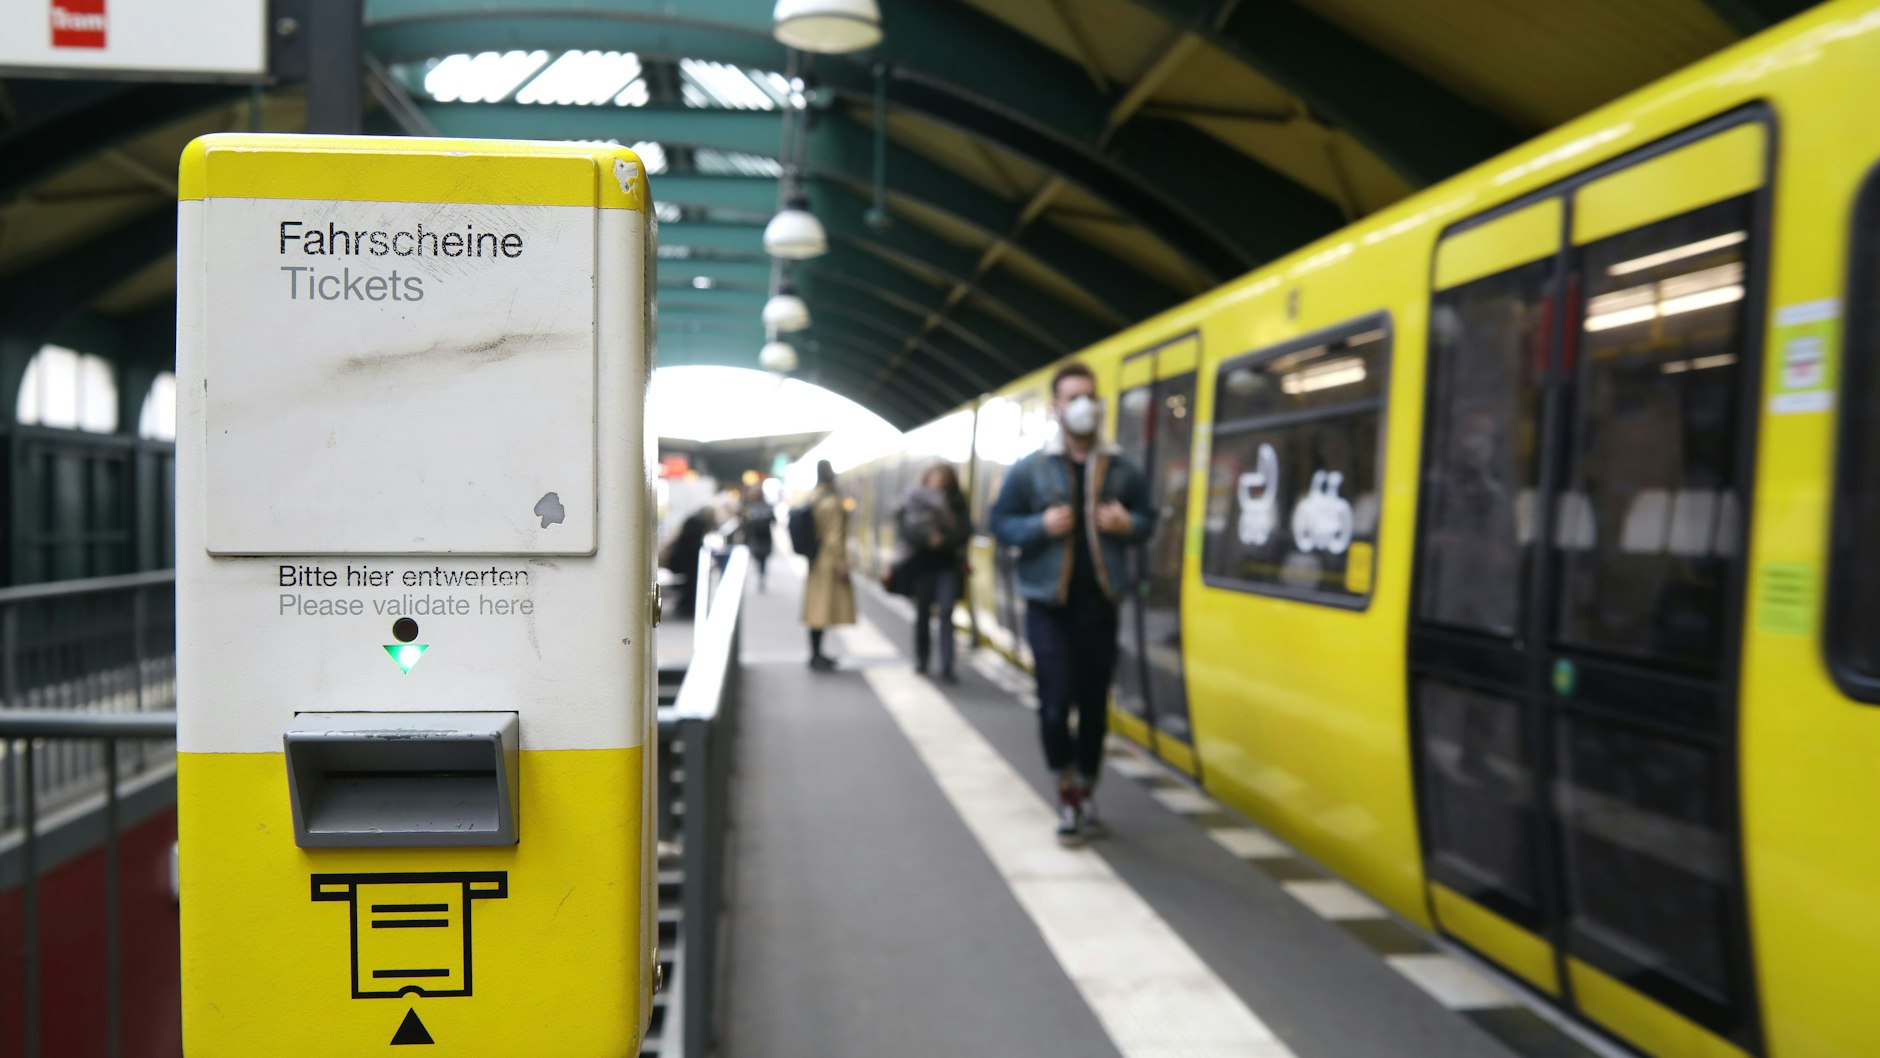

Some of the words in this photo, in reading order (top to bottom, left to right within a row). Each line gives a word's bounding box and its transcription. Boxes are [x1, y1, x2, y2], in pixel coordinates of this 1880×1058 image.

[279, 221, 524, 258] Fahrscheine
[280, 266, 425, 301] Tickets
[279, 565, 338, 587] Bitte
[347, 565, 394, 587] hier
[402, 566, 529, 587] entwerten
[279, 594, 364, 616] Please
[373, 594, 470, 616] validate
[479, 594, 535, 616] here
